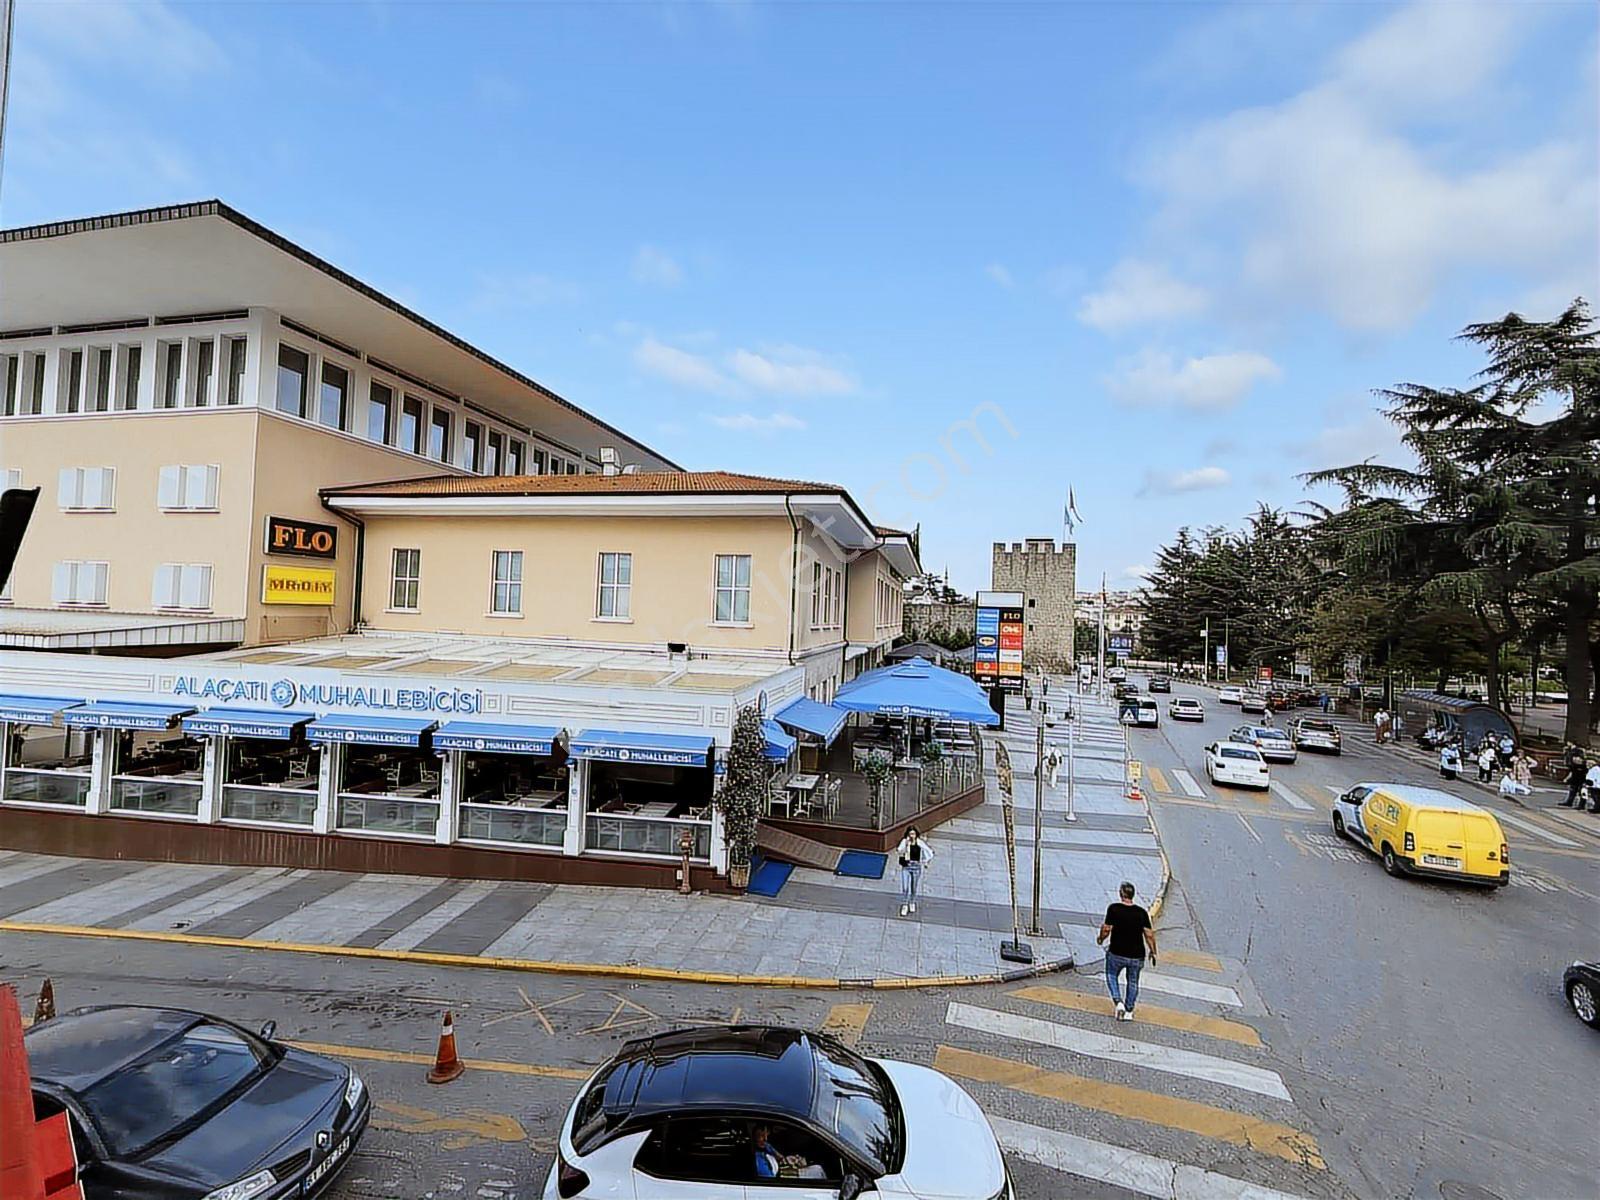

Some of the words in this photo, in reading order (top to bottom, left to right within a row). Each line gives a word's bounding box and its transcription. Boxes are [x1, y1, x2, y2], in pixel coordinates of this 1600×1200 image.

[272, 524, 333, 552] FLO
[1003, 612, 1021, 620] FLO
[173, 676, 268, 702] ALAÇATI
[299, 683, 484, 714] MUHALLEBİCİSİ
